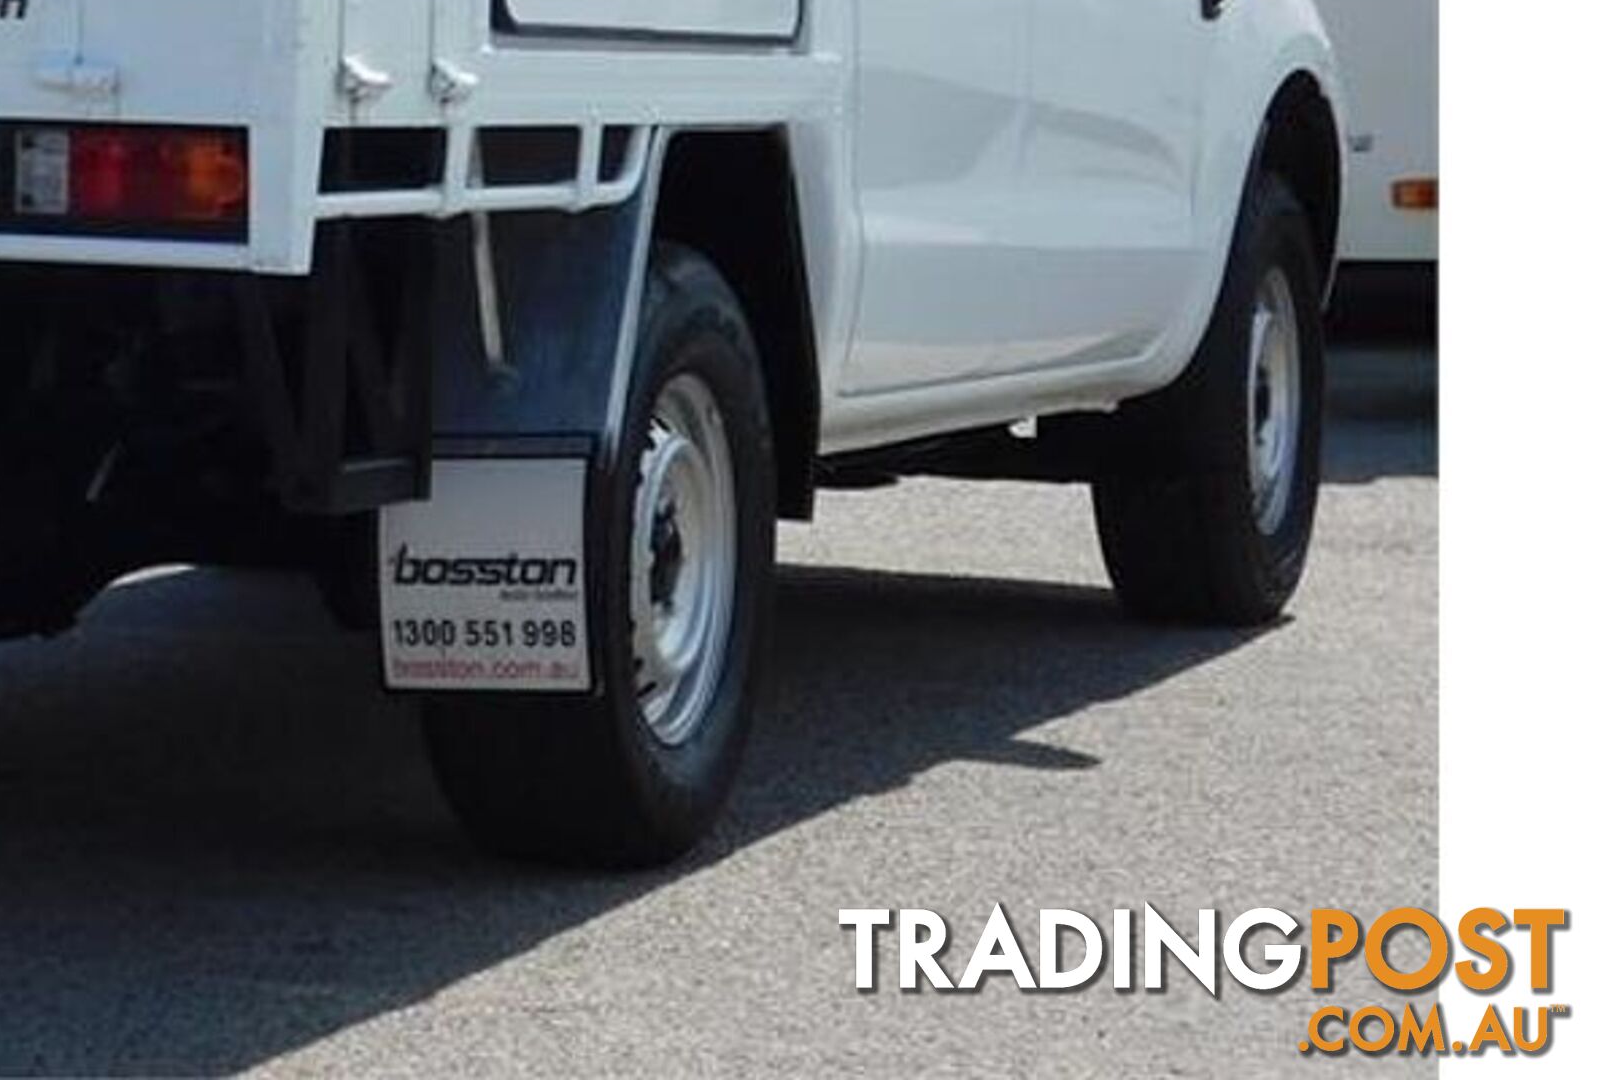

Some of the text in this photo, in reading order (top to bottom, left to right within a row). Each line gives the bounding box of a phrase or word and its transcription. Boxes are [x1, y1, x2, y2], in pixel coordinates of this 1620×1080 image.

[389, 541, 577, 587] bosston
[394, 619, 577, 647] 1300 551 998
